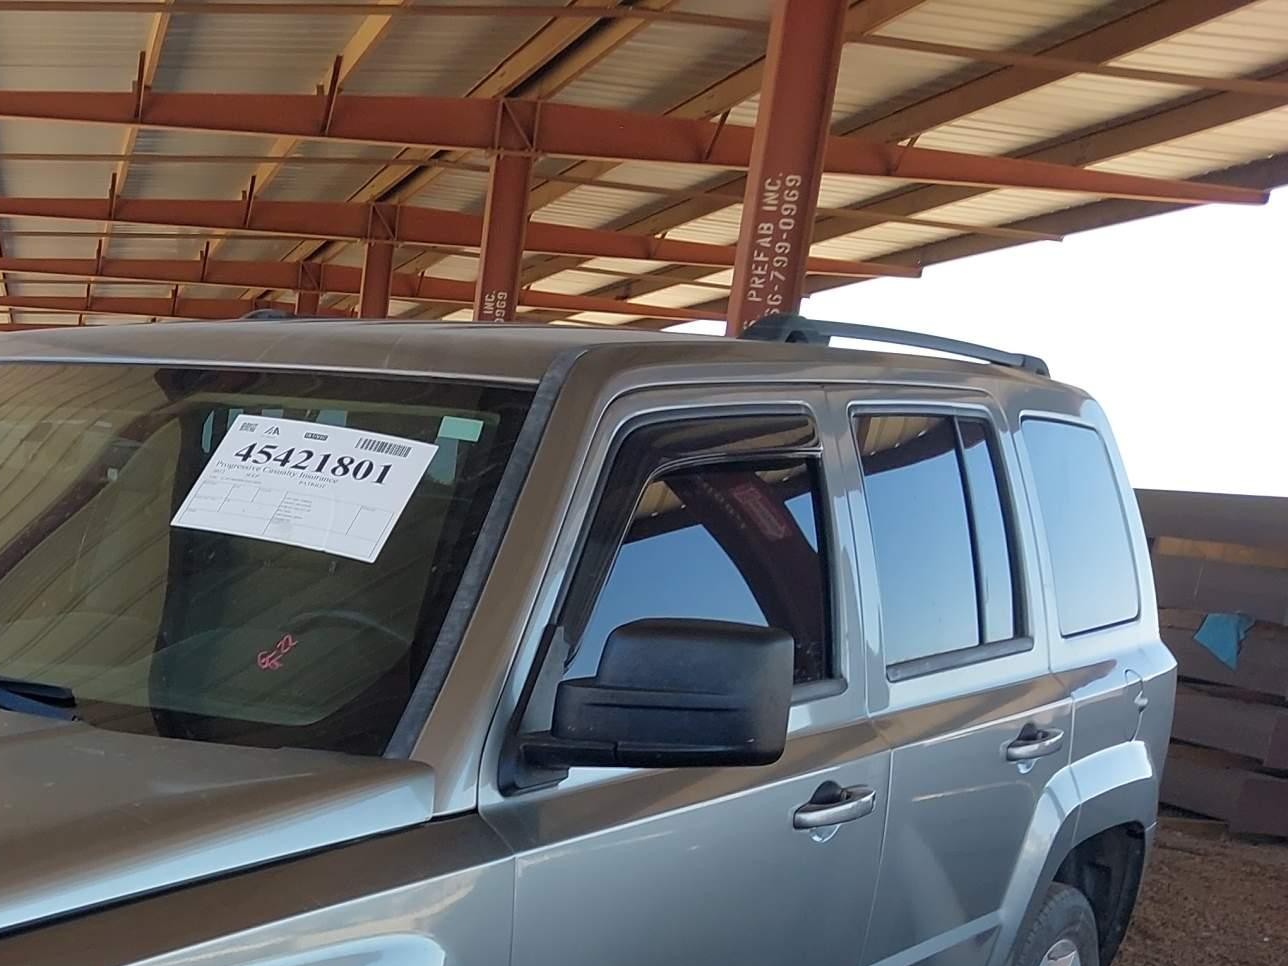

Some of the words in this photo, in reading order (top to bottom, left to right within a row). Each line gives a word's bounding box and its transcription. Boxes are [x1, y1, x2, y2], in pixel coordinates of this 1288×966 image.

[747, 222, 775, 302] PREFAB
[763, 172, 783, 211] INC.
[483, 290, 496, 315] INC.
[215, 460, 262, 474] Progressive
[262, 467, 297, 478] Casualty
[299, 471, 339, 484] Insurance
[234, 442, 393, 485] 45421801
